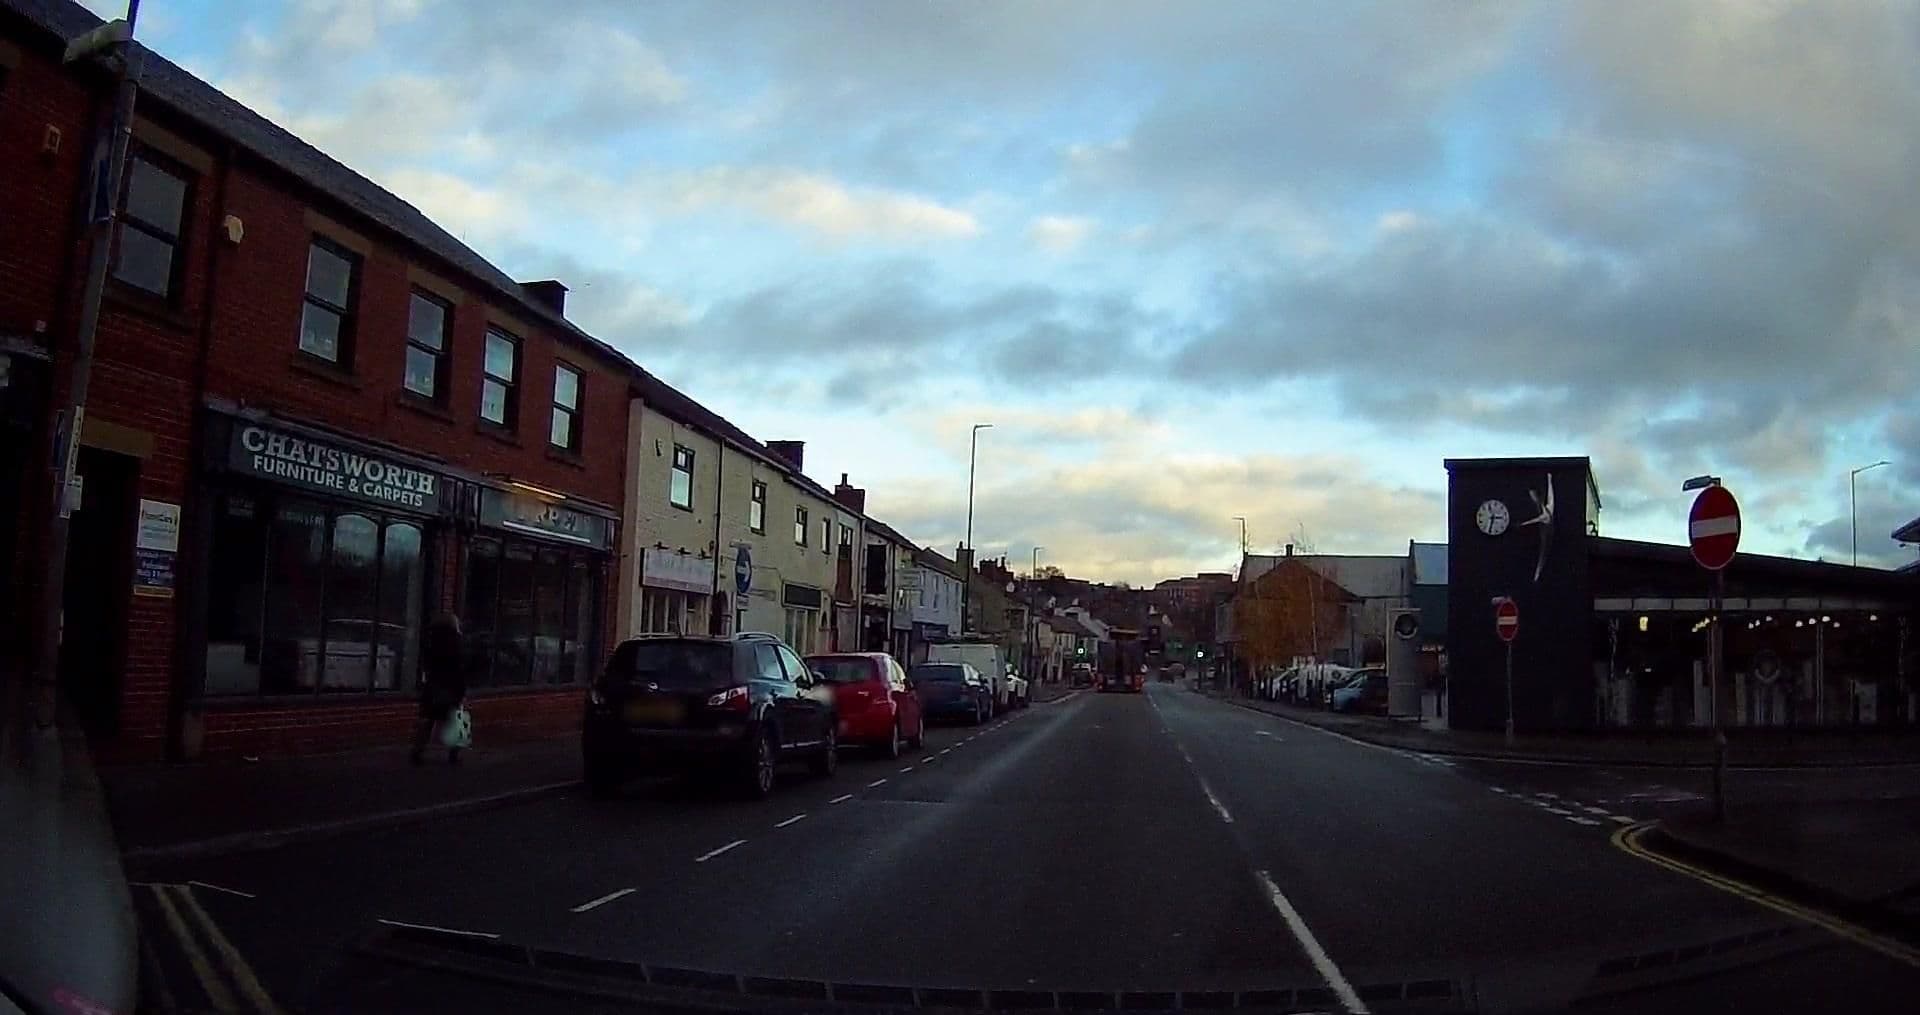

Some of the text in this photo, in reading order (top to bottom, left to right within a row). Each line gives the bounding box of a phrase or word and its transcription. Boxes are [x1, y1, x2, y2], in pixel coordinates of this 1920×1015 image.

[242, 426, 435, 495] CHATSWORTH
[253, 455, 423, 507] FURNITURE & CARPETS
